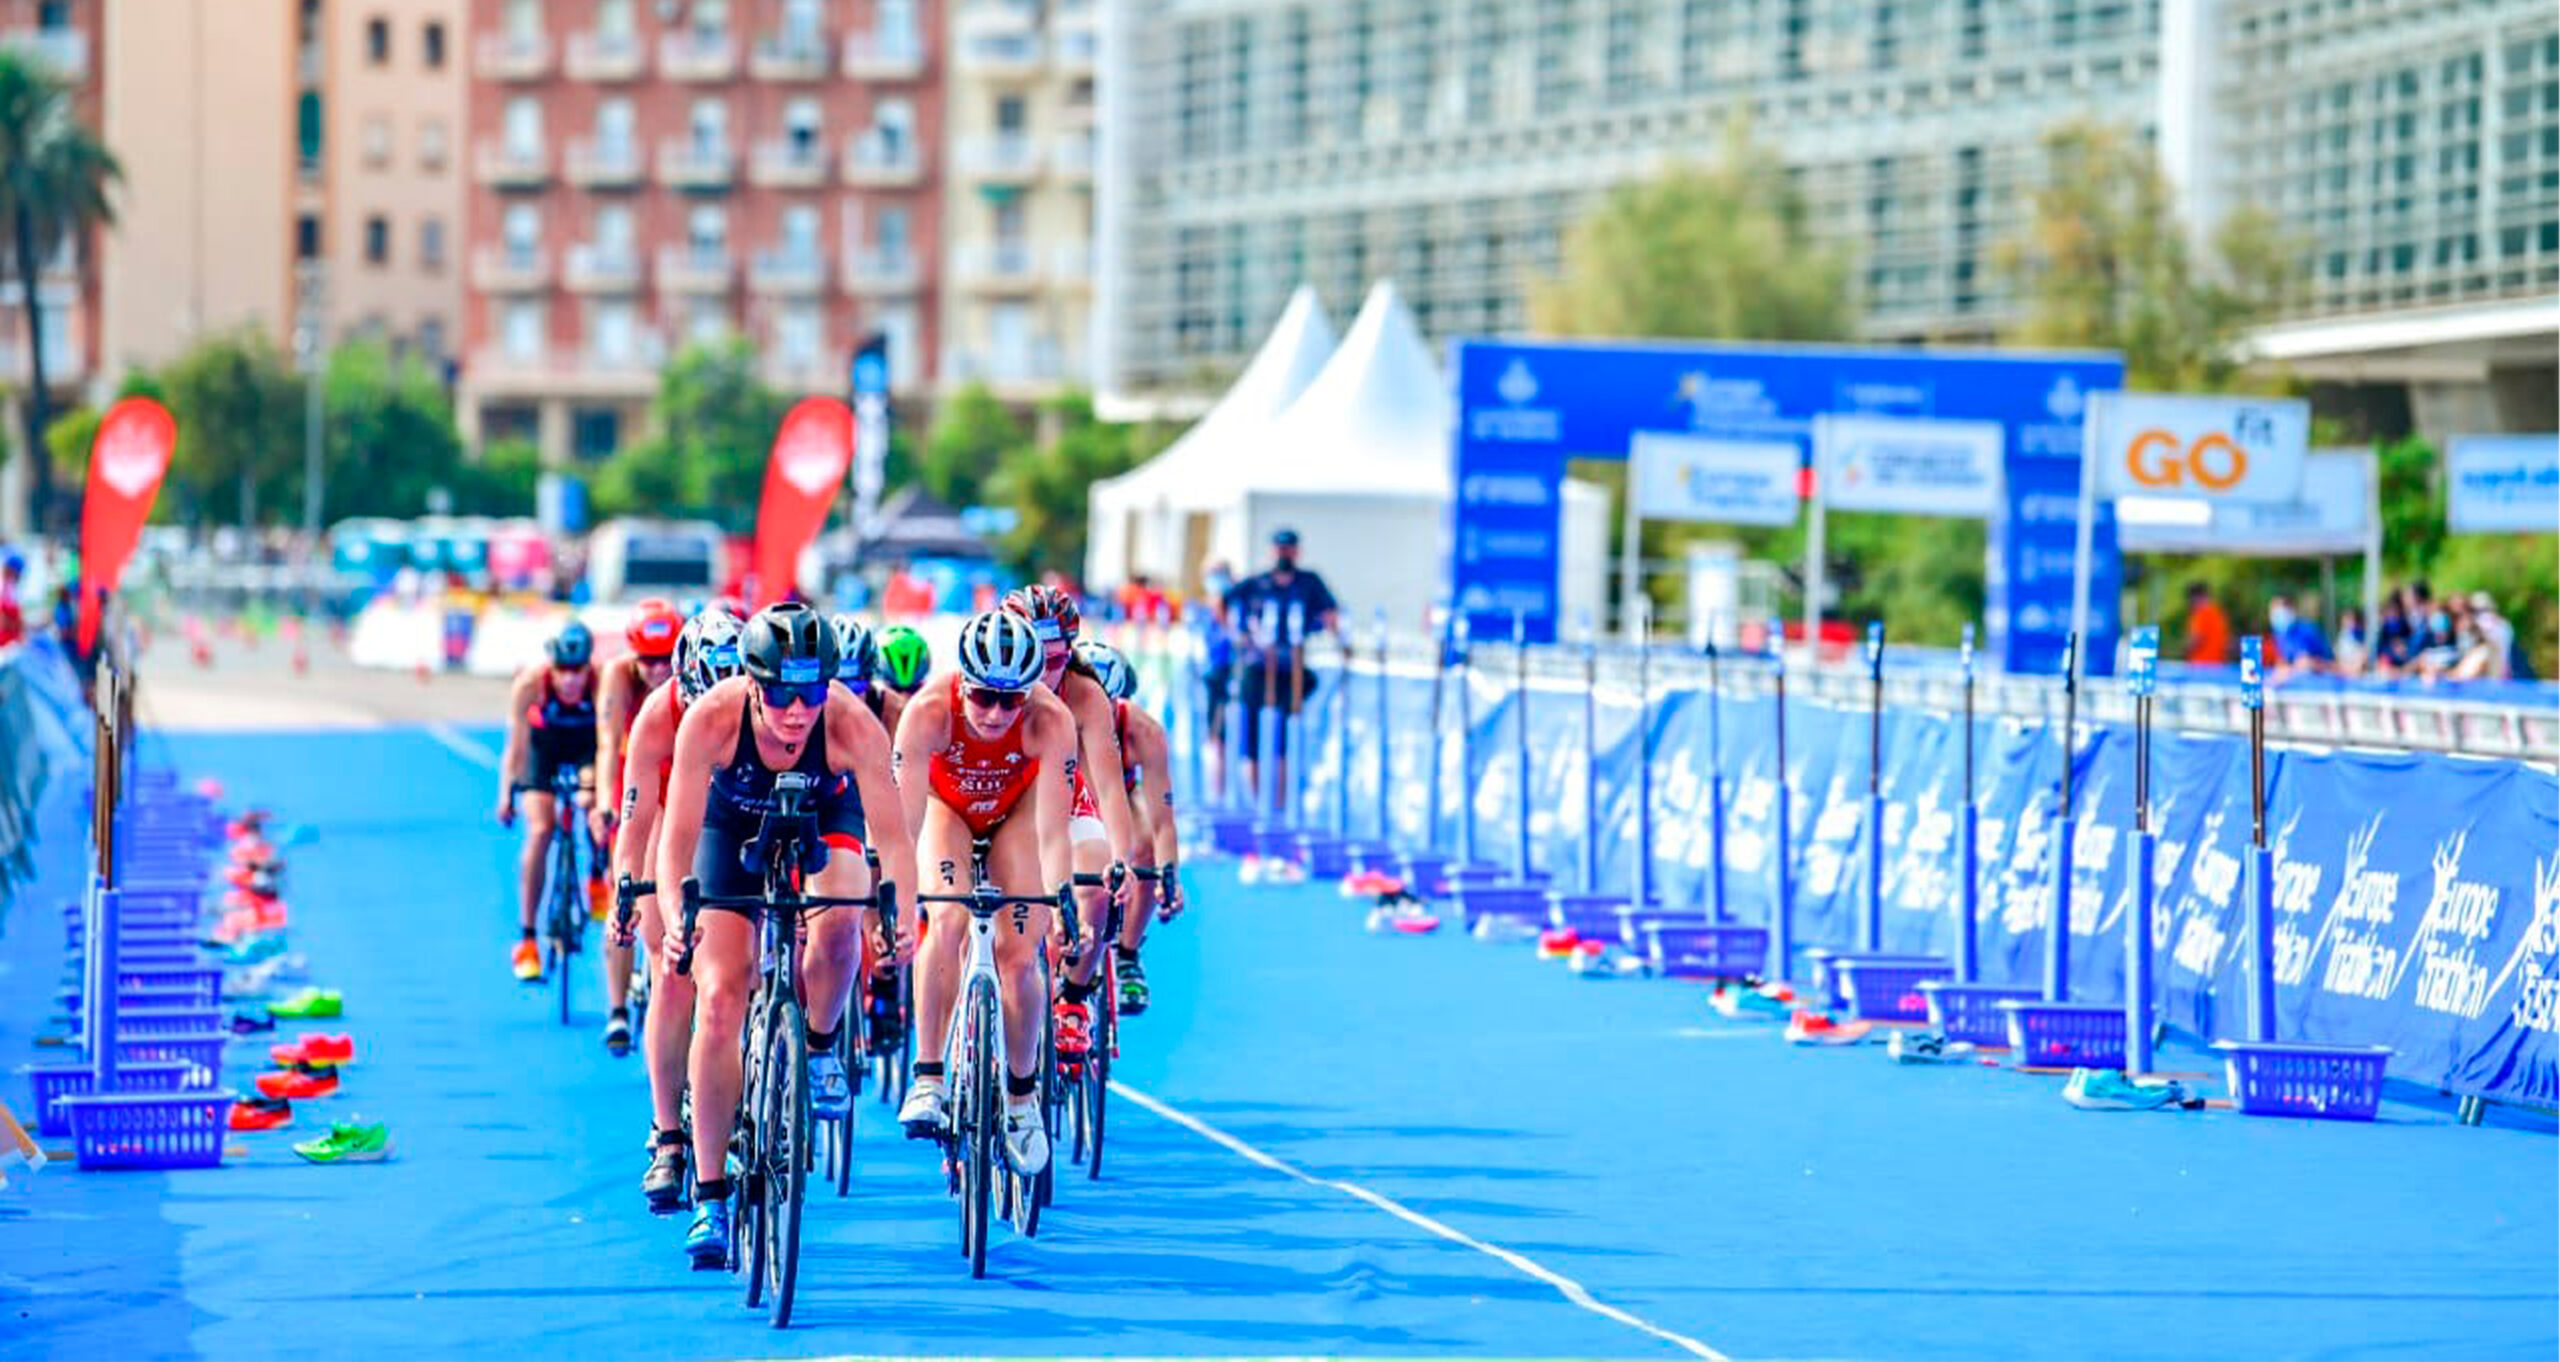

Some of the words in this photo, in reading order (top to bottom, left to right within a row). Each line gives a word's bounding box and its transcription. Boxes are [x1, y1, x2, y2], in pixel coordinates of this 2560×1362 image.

[2126, 428, 2248, 490] GO
[940, 861, 955, 885] 21
[2341, 870, 2399, 932] Europe
[1012, 903, 1029, 934] 21
[2434, 880, 2499, 946] Europe
[2414, 938, 2488, 1019] Triathlon
